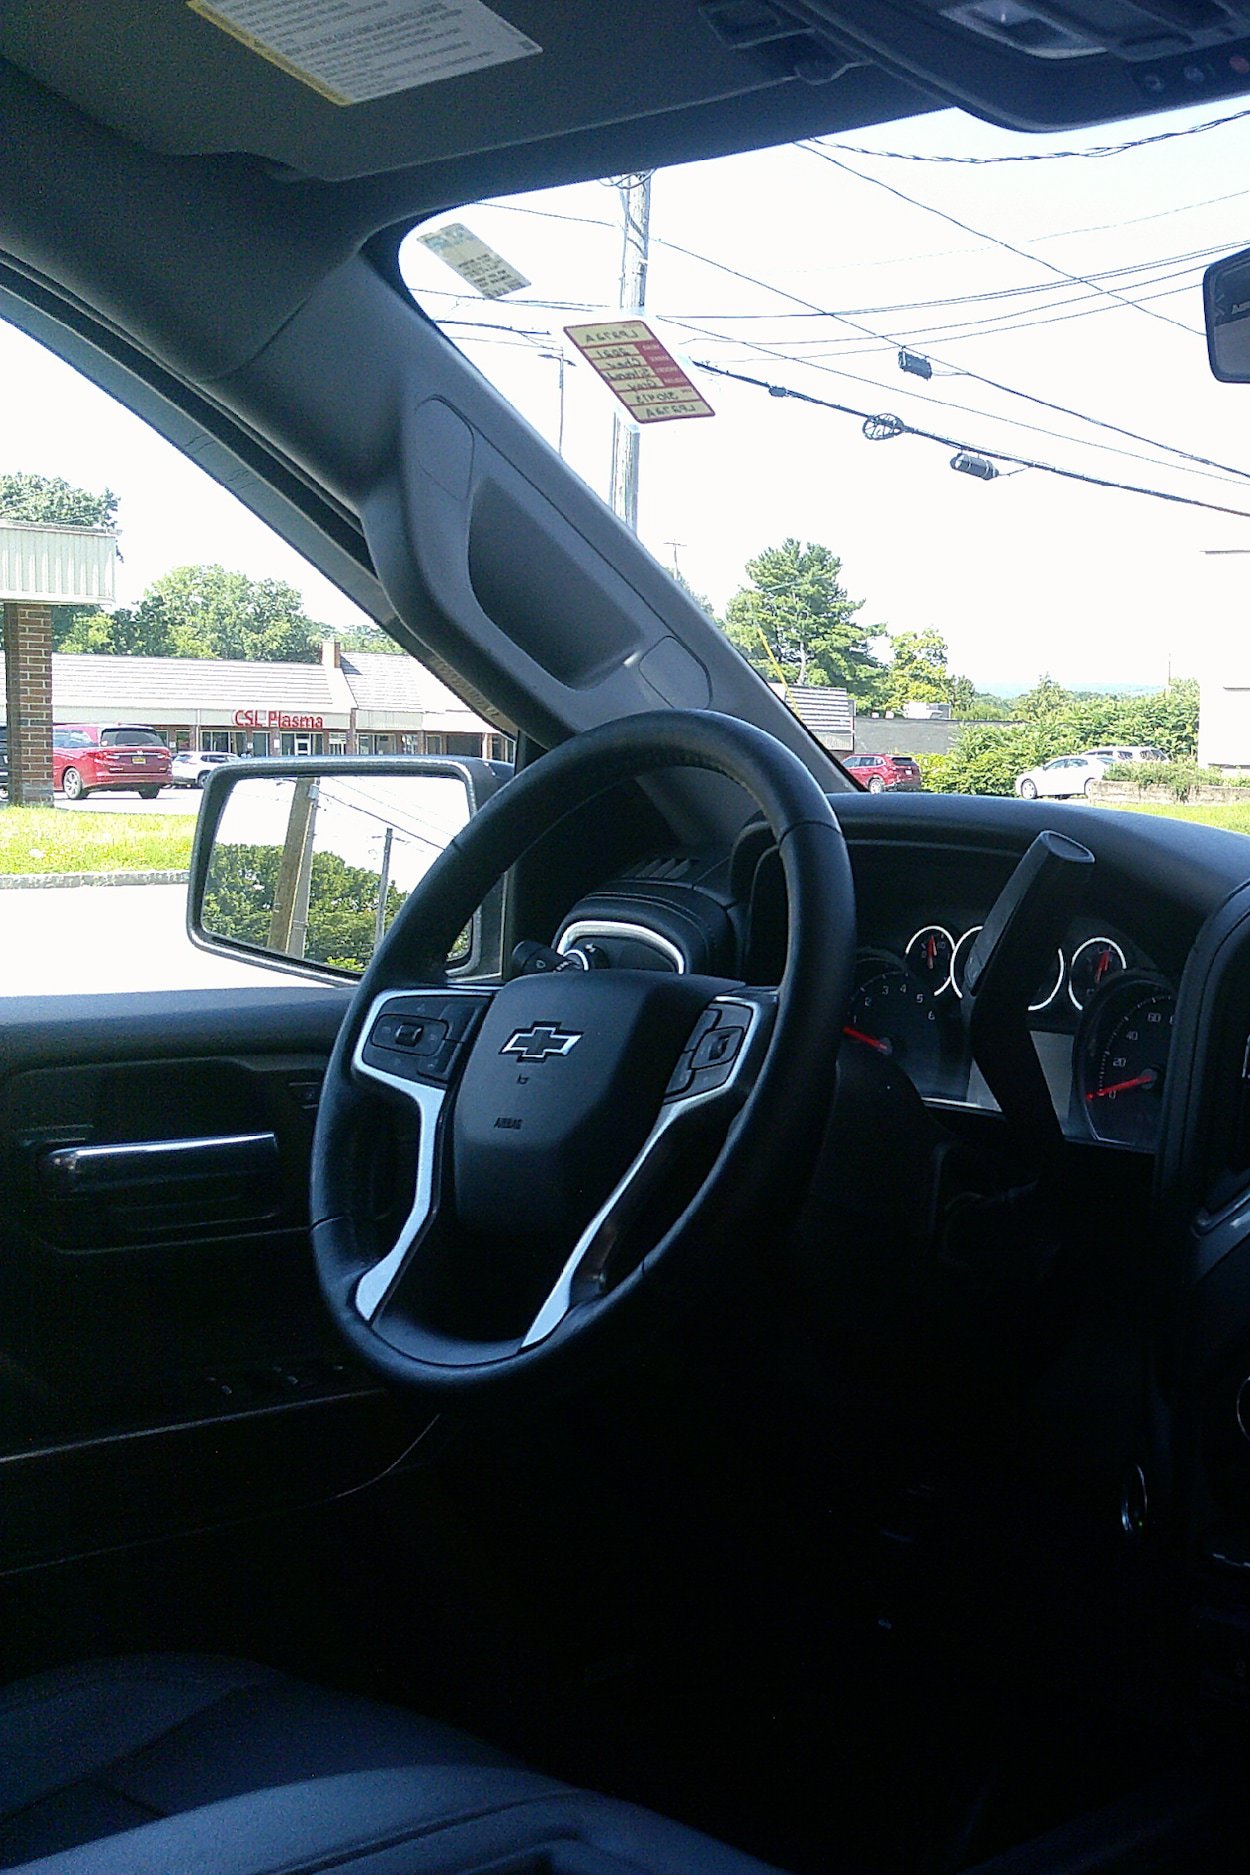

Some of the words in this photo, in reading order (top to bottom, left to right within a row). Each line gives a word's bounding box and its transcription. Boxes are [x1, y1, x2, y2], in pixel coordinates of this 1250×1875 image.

[234, 709, 264, 727] CSL
[268, 710, 324, 728] Plasma
[916, 993, 925, 1004] 5
[927, 1010, 936, 1021] 6
[1113, 1056, 1127, 1068] 20
